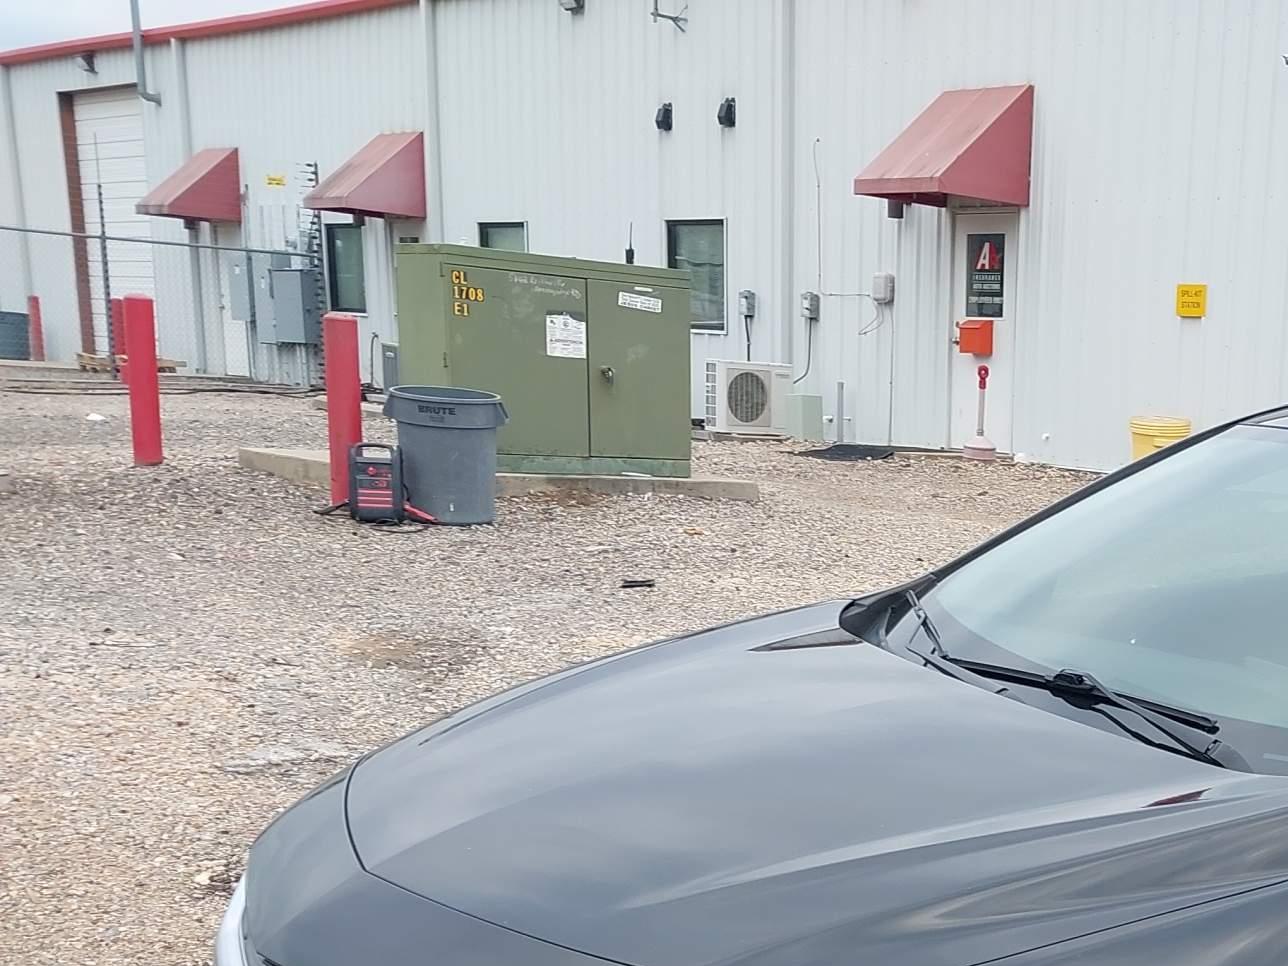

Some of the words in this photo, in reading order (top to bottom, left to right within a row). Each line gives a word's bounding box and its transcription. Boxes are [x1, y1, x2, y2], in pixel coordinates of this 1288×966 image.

[451, 270, 467, 285] CL
[452, 285, 485, 303] 1708
[453, 302, 470, 317] E1
[417, 404, 457, 416] BRUTE
